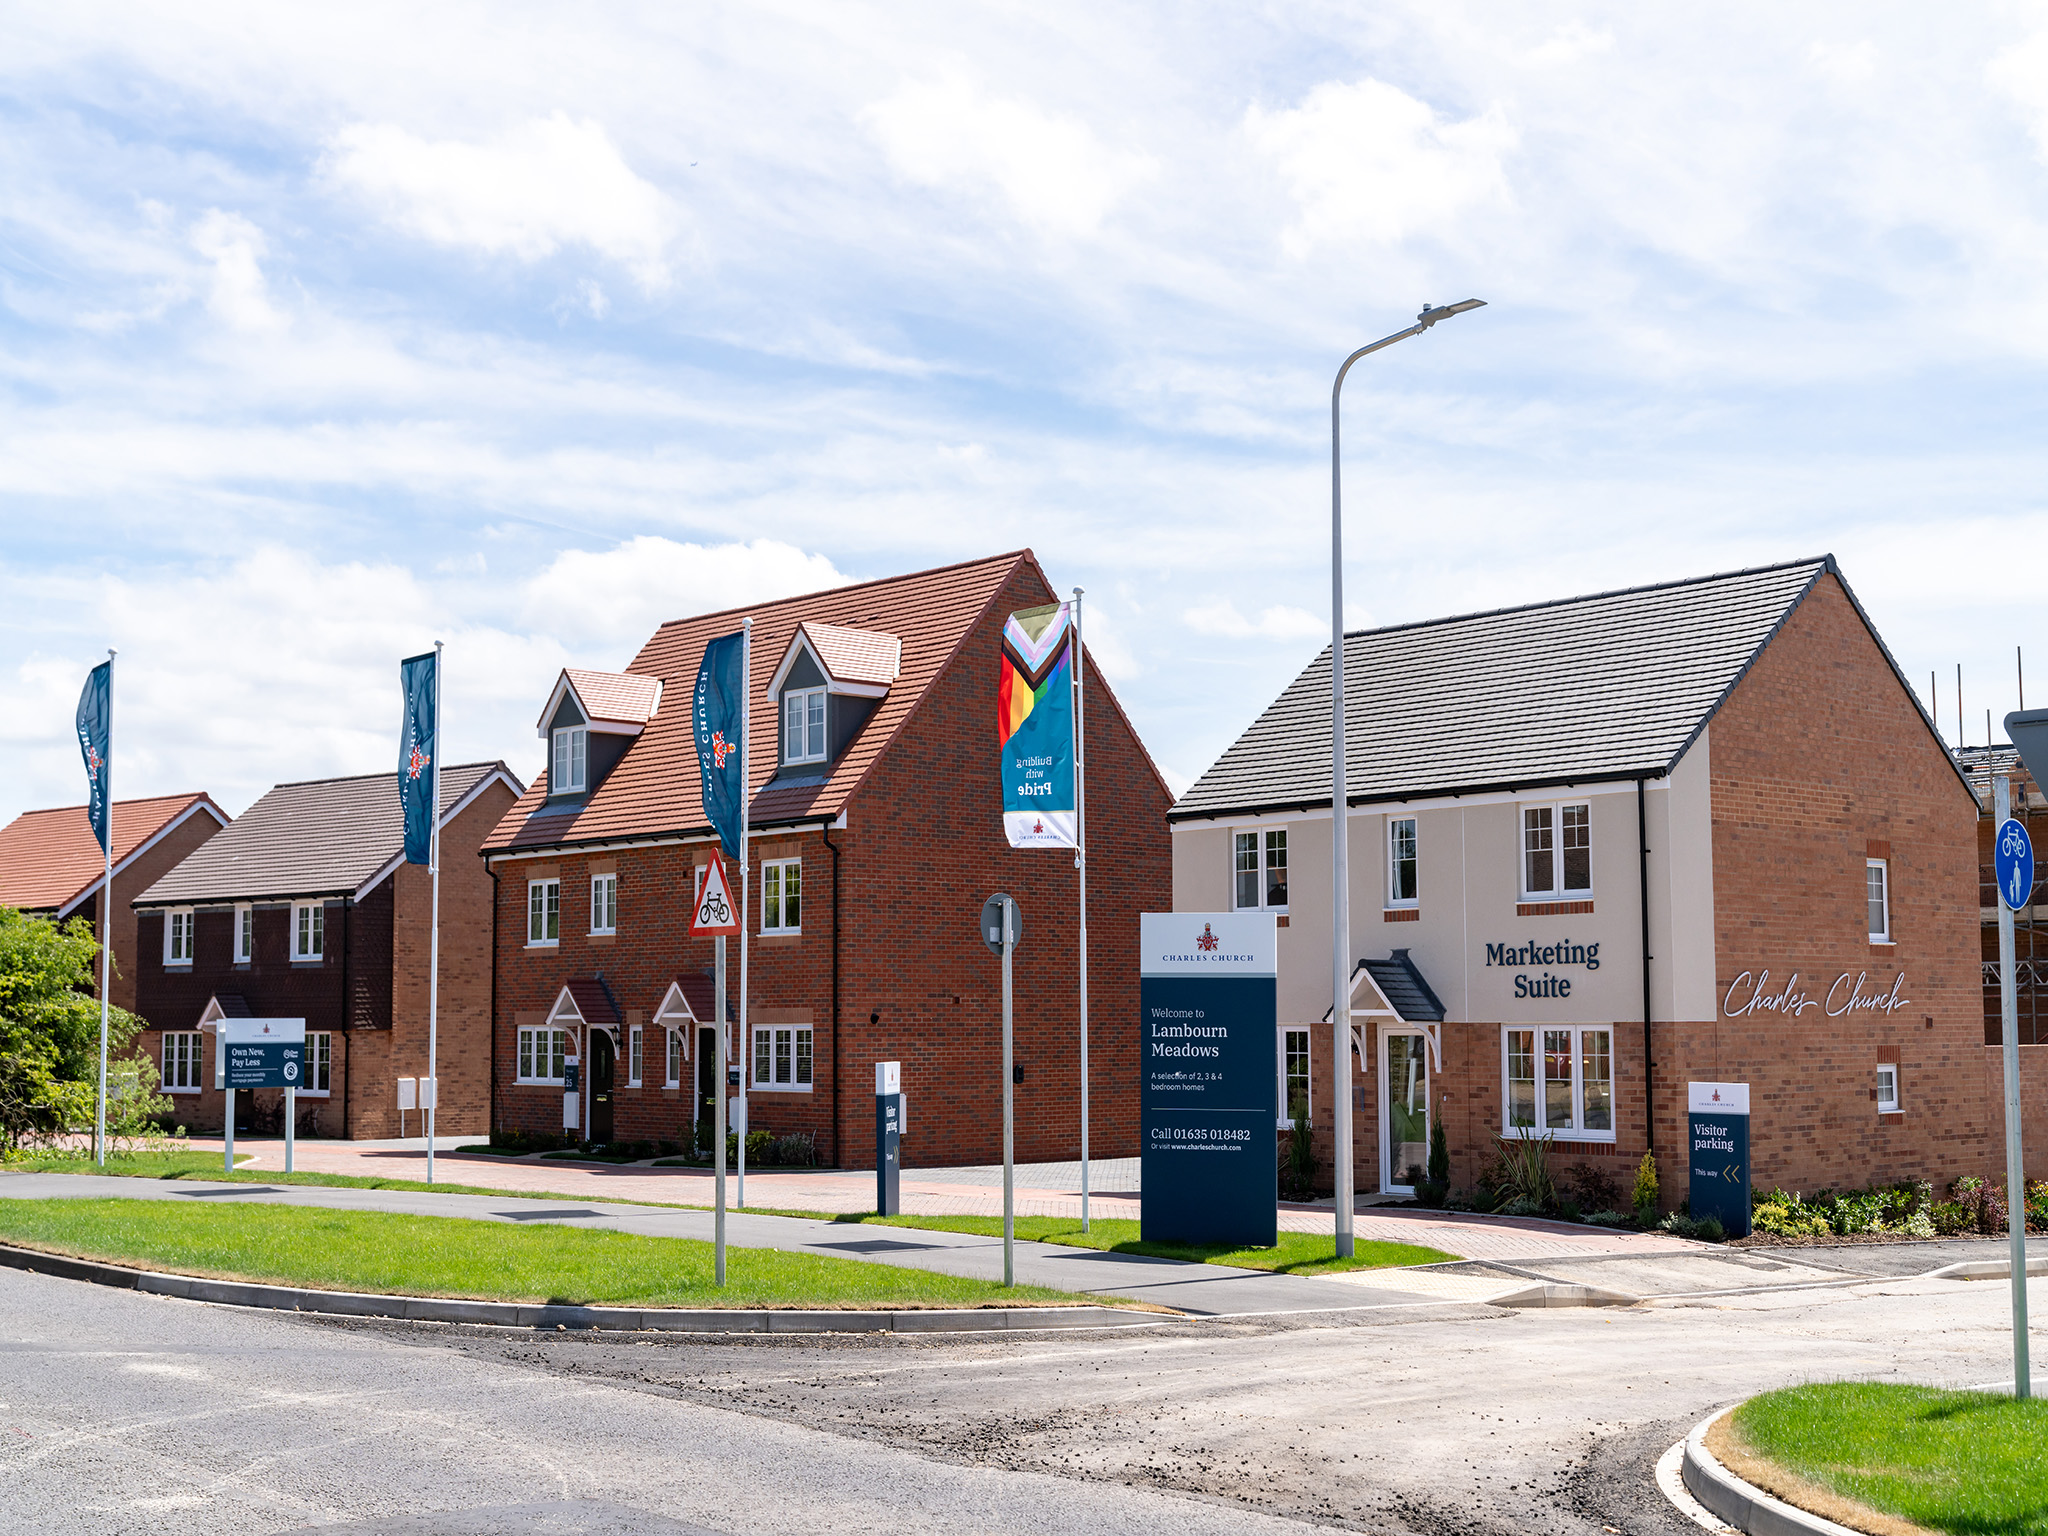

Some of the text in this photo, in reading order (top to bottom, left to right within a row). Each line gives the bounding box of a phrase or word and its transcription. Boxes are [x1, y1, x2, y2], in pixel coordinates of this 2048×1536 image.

[1485, 939, 1600, 970] Marketing
[1514, 973, 1571, 999] Suite
[1724, 969, 1911, 1017] Charles Church
[1151, 1008, 1204, 1018] Welcome to
[1151, 1024, 1228, 1038] Lambourn
[232, 1048, 265, 1056] Own New,
[1151, 1043, 1219, 1058] Meadows
[232, 1058, 244, 1068] Pay
[1151, 1072, 1156, 1080] A
[1188, 1072, 1196, 1080] of
[1197, 1072, 1204, 1082] 2,
[1151, 1082, 1205, 1091] bedroom homes
[1151, 1128, 1251, 1140] Call 01635 018482
[1695, 1124, 1728, 1136] Visitor
[1171, 1143, 1242, 1151] www.charleschurch.com
[1695, 1138, 1734, 1152] parking
[1707, 1170, 1718, 1178] way
